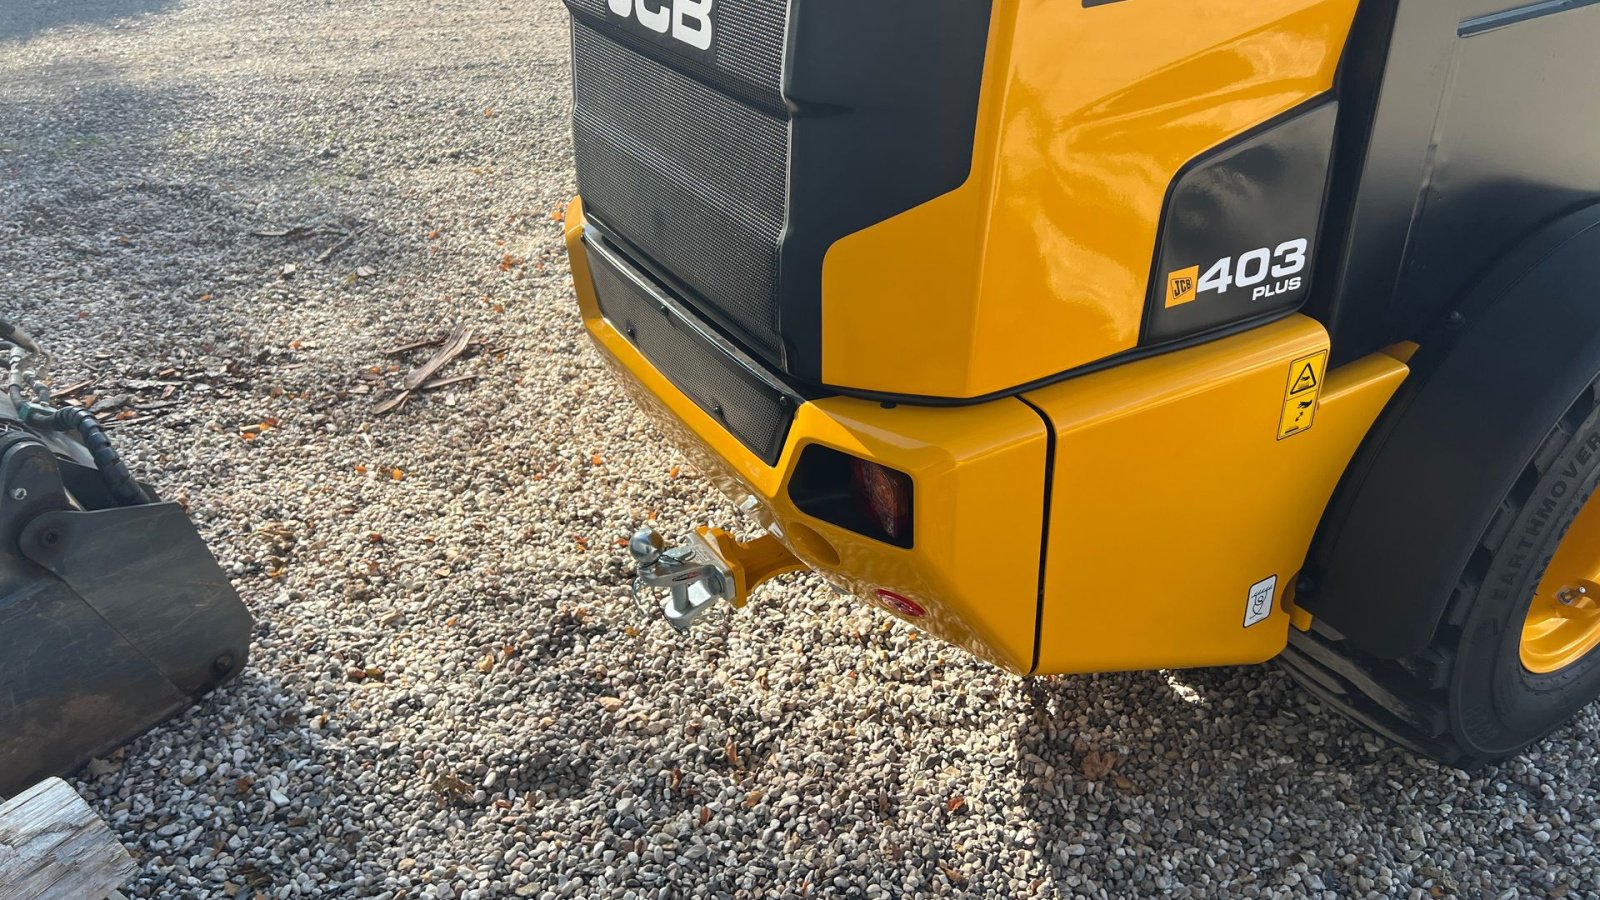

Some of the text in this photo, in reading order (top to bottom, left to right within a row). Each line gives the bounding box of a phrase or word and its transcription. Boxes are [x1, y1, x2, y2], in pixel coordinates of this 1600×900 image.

[607, 0, 712, 50] CB
[1196, 238, 1308, 294] 403
[1174, 279, 1192, 297] JCB
[1252, 276, 1302, 301] PLUS
